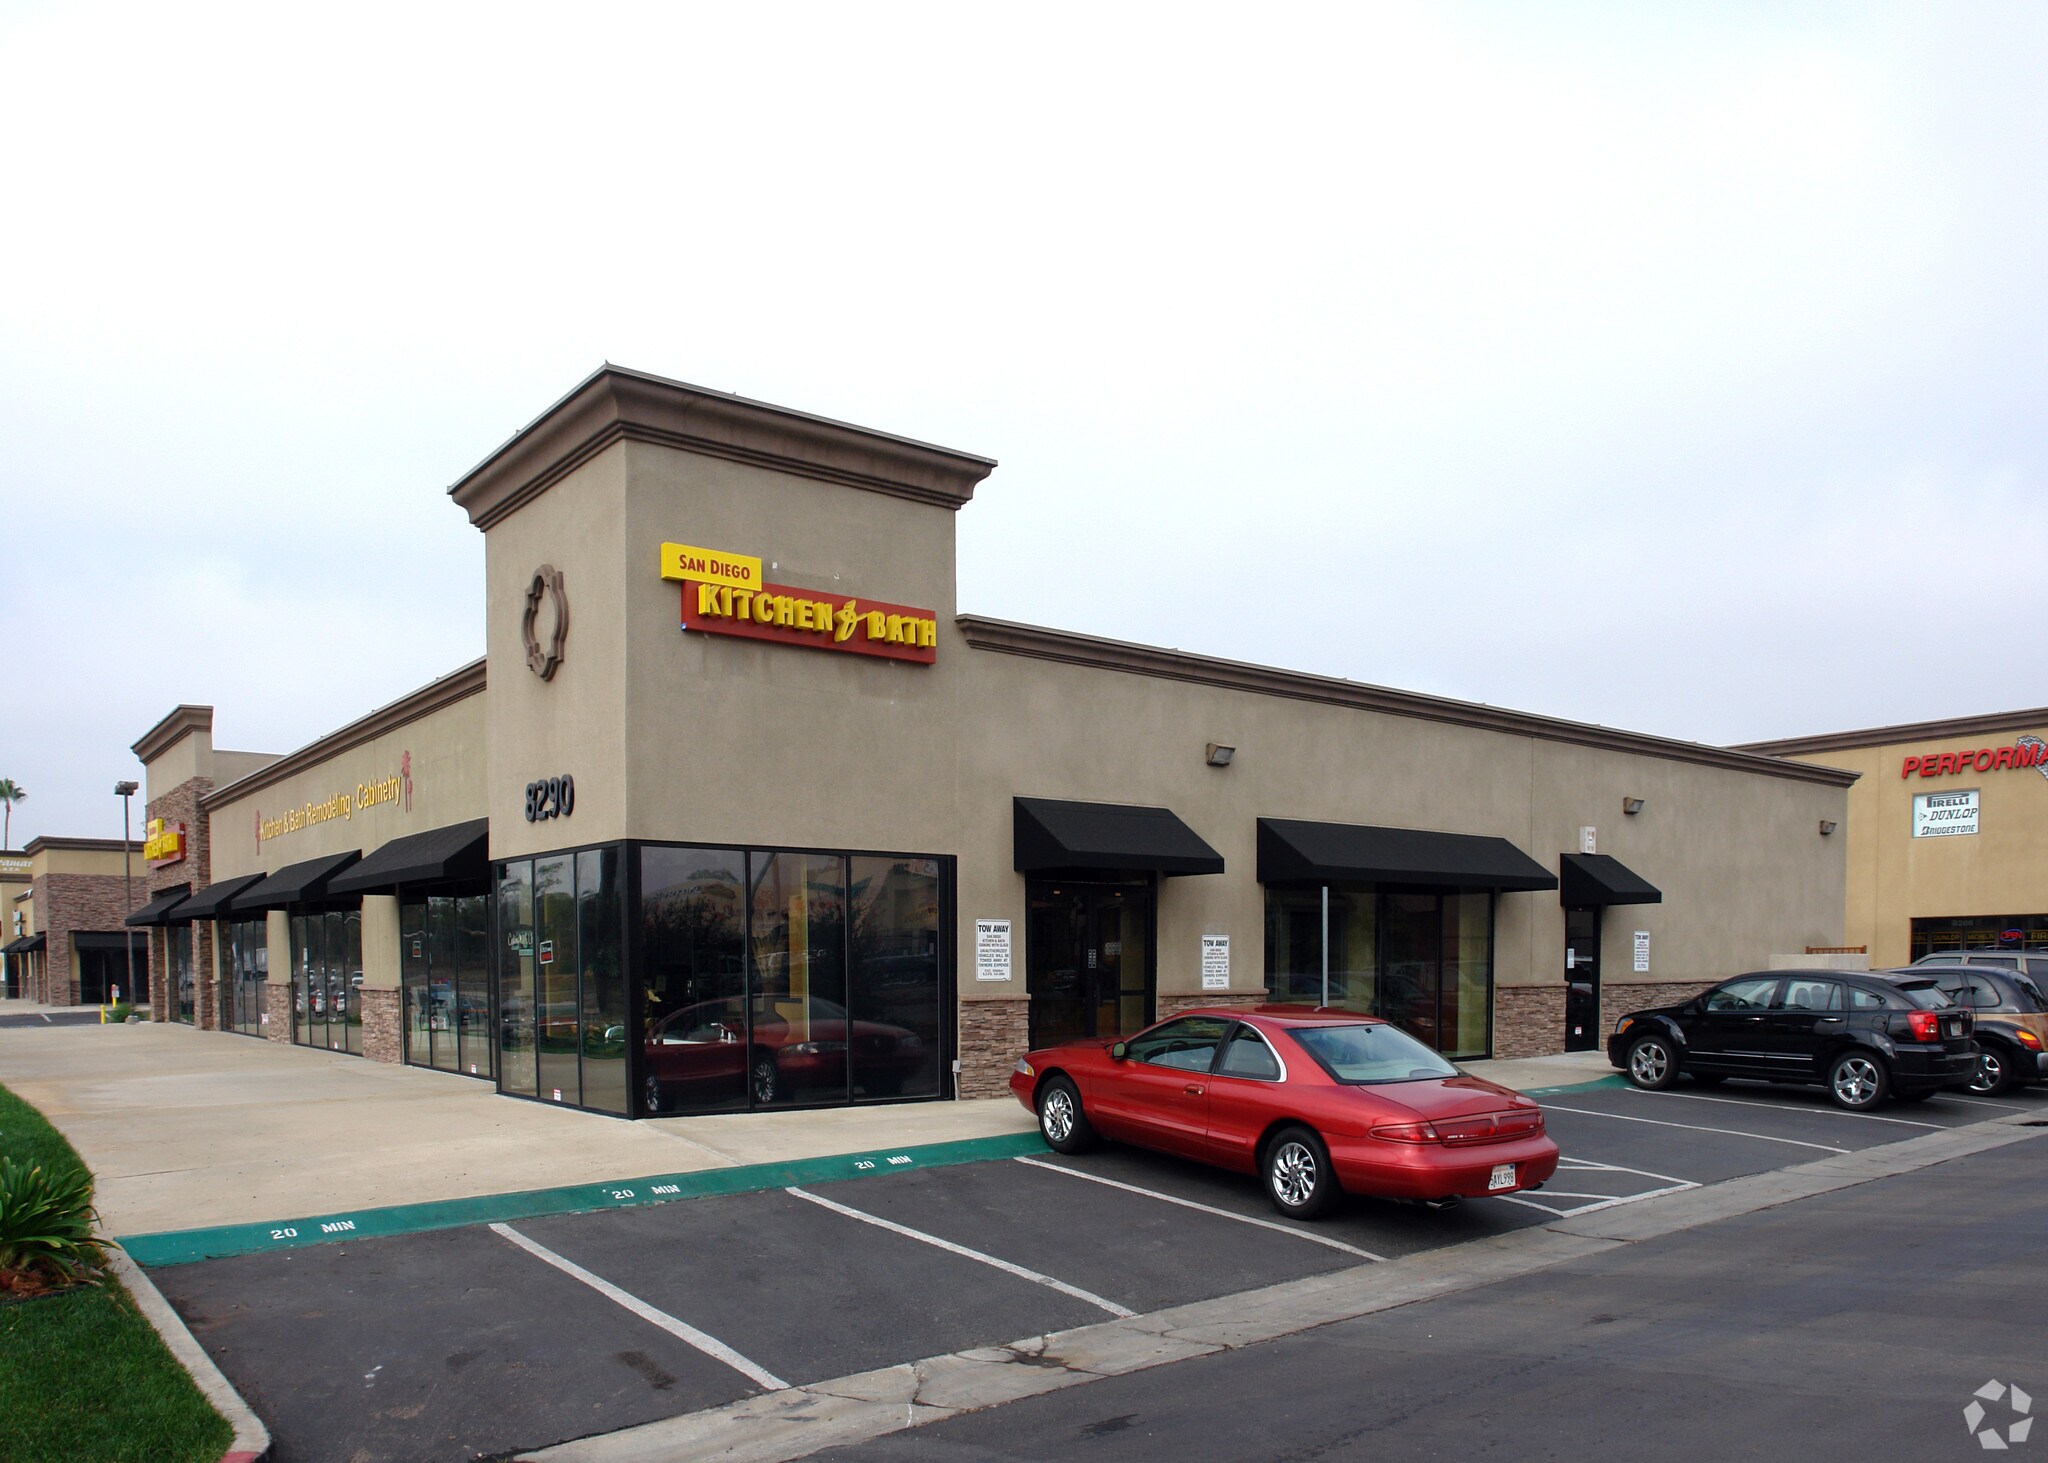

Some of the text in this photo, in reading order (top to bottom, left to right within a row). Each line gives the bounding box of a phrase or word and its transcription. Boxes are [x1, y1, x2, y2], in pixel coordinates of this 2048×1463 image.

[679, 554, 750, 580] SAN DIEGO
[698, 583, 833, 632] KITCHEN
[867, 610, 937, 647] BATH
[306, 791, 352, 826] Remodeling
[357, 773, 402, 811] Cabinetry
[525, 773, 575, 823] 8290
[1926, 793, 1970, 808] PIRELLI
[1928, 808, 1978, 821] DUNLOP
[1920, 825, 1976, 836] BRIDGESTONE
[978, 924, 1009, 933] TOW AWAY
[2000, 931, 2023, 940] OPEN
[854, 1155, 913, 1170] 20 MIN
[612, 1184, 681, 1199] 20 MIN
[270, 1220, 356, 1240] 20 MIN
